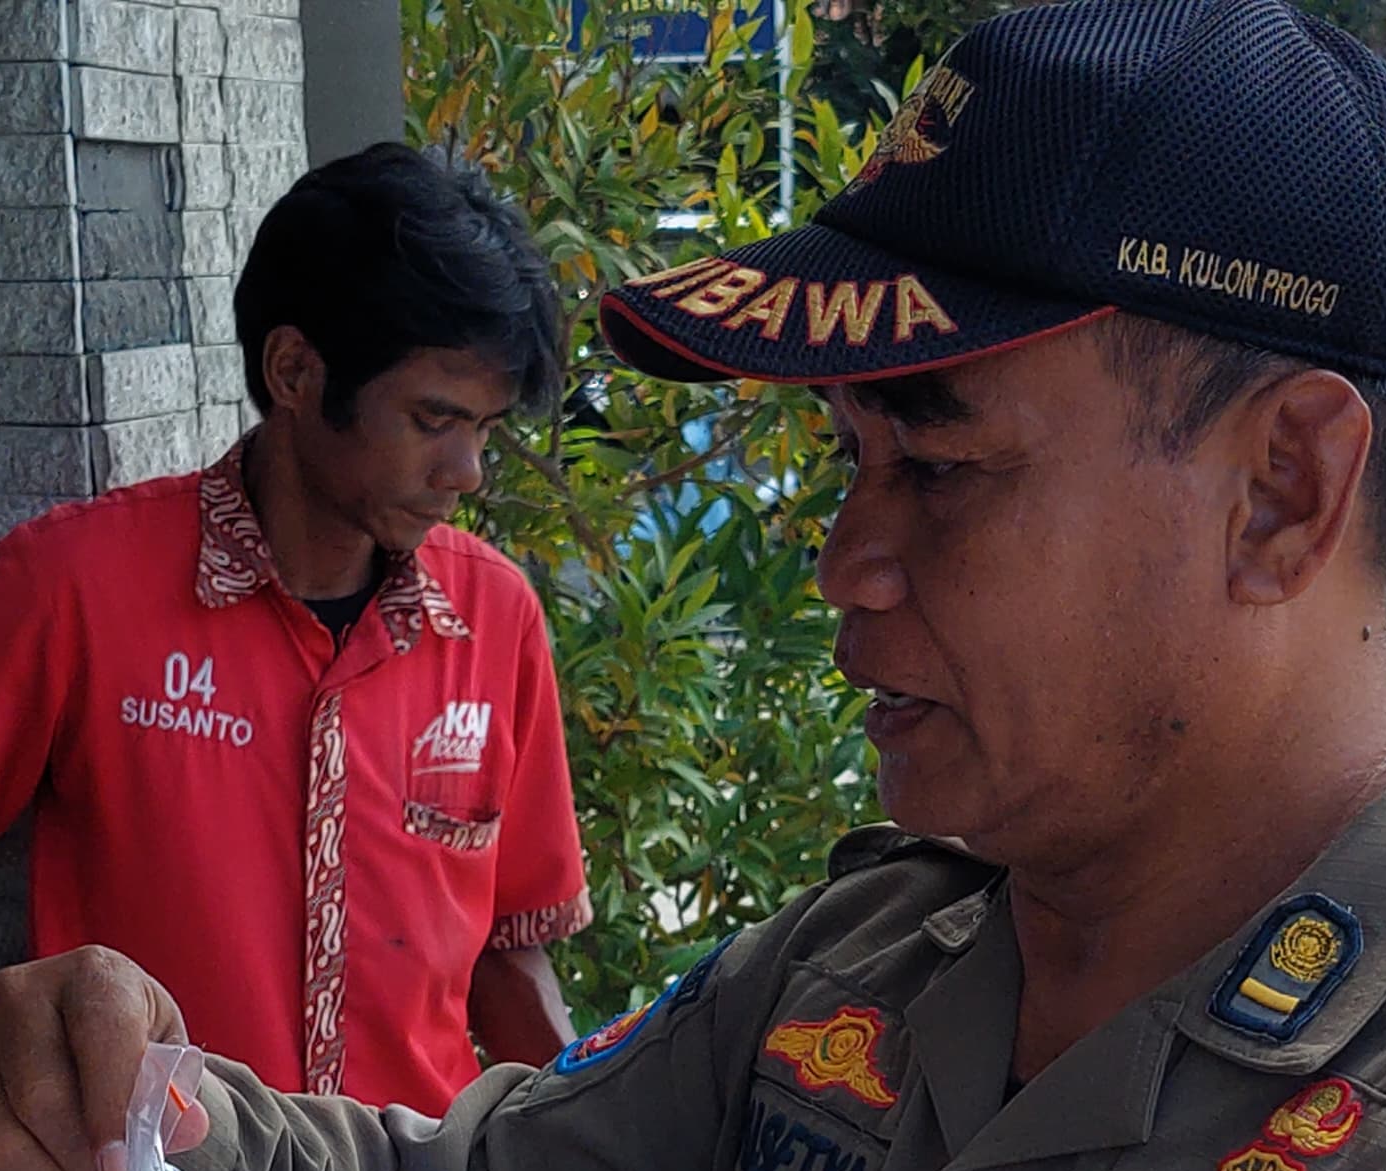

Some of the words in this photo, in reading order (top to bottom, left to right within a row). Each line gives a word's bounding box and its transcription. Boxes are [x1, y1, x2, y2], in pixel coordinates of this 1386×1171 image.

[1117, 236, 1171, 279] KAB.
[1178, 247, 1260, 300] KULON
[1260, 268, 1339, 317] PROGO
[164, 651, 217, 705] 04
[120, 696, 254, 748] SUSANTO
[444, 701, 493, 739] KAI
